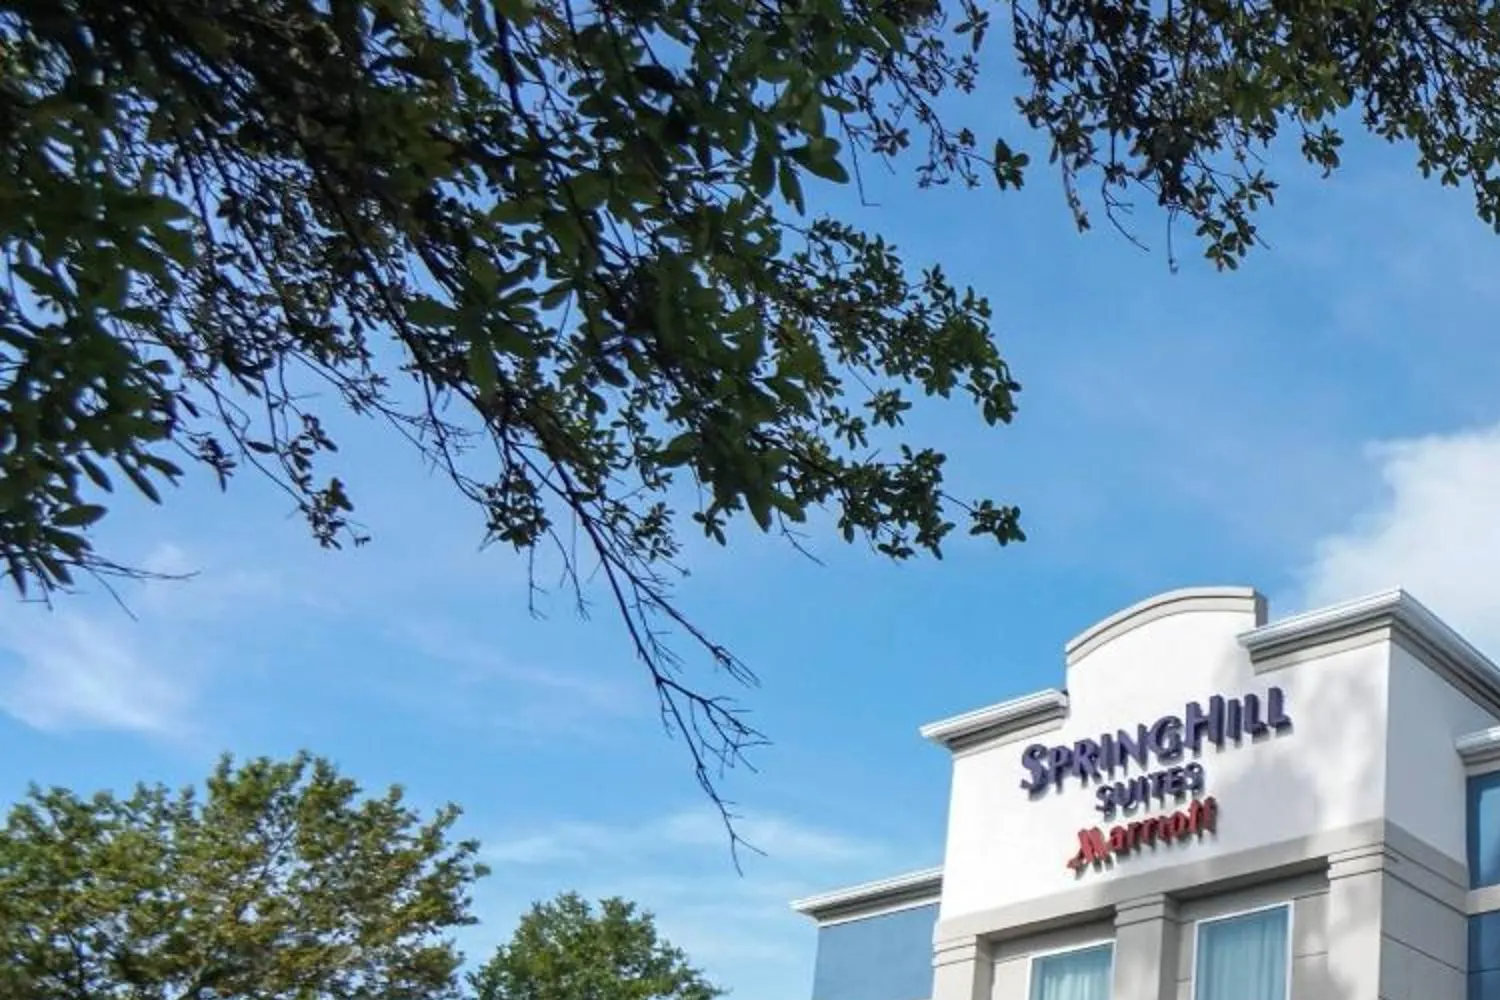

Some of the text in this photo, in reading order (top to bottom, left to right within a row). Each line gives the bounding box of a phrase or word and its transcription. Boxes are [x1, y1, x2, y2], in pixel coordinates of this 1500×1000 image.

[1020, 687, 1292, 797] SPRINGHILL
[1095, 762, 1205, 820] SUITES
[1067, 795, 1218, 874] Marriott
